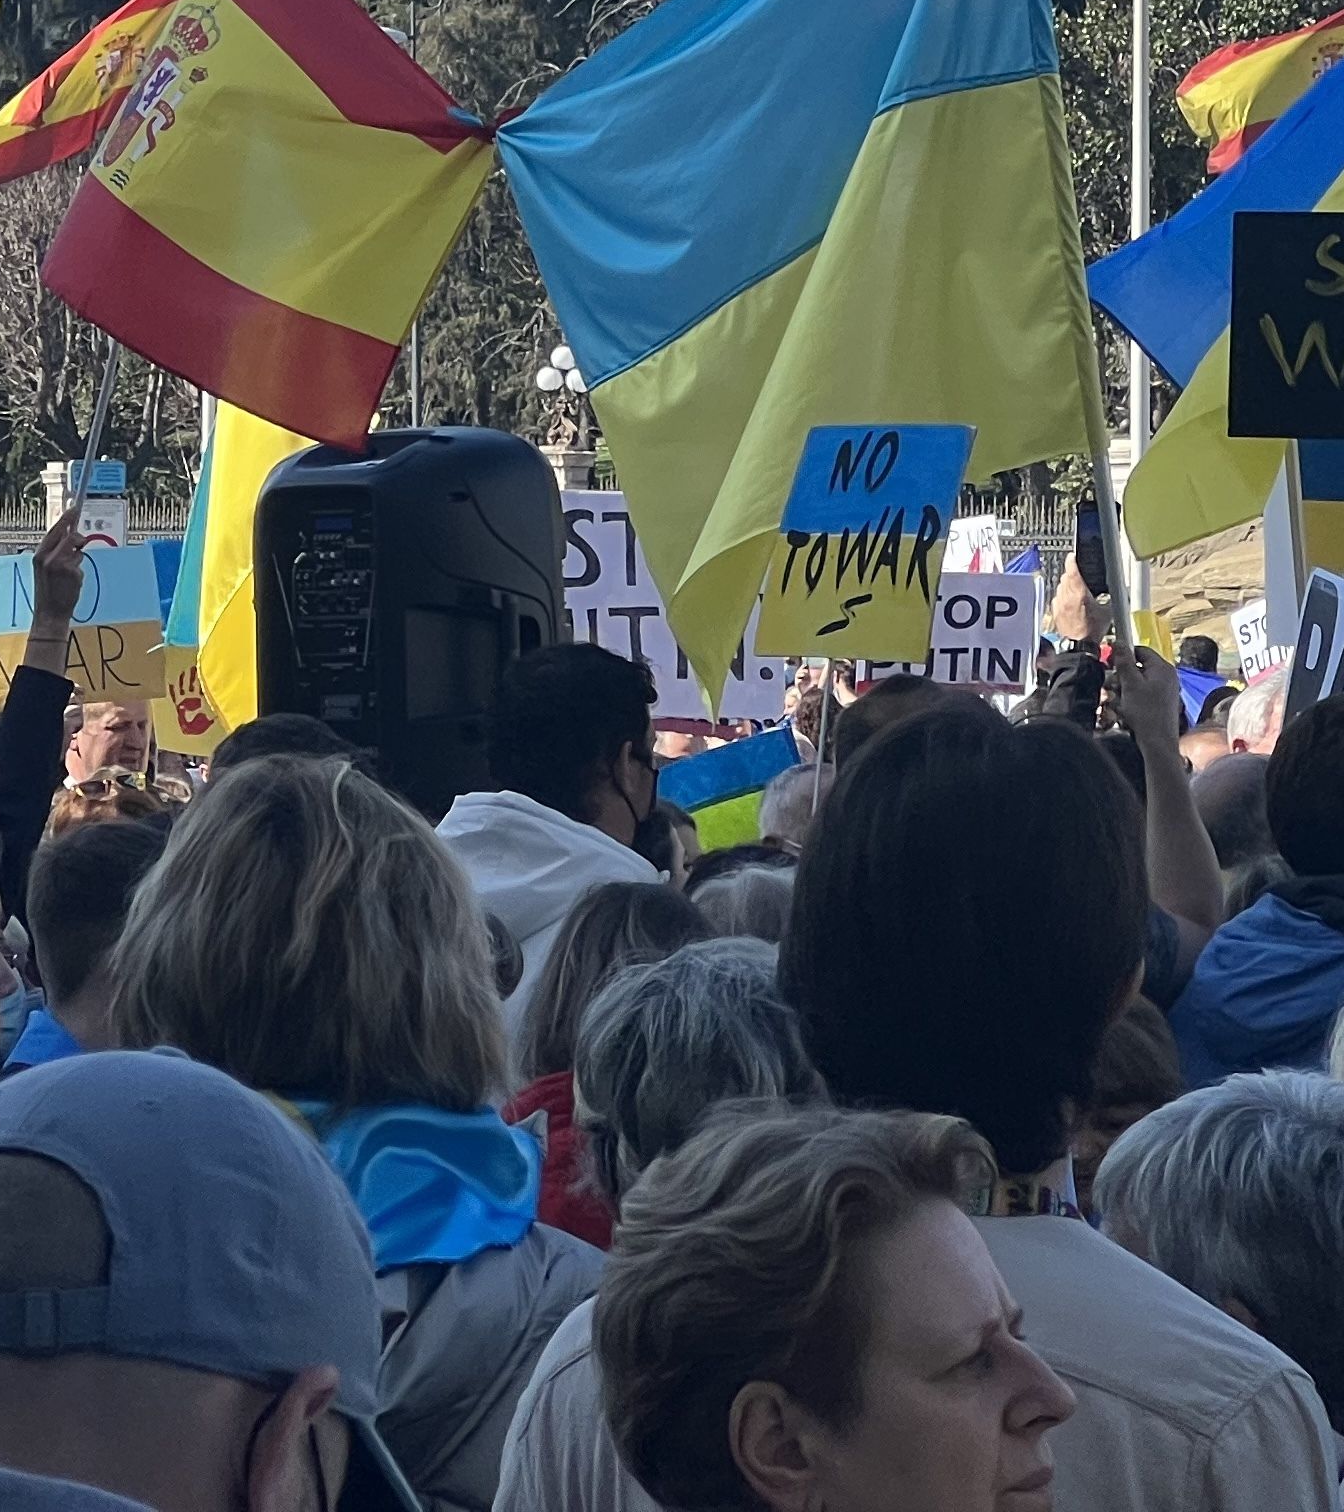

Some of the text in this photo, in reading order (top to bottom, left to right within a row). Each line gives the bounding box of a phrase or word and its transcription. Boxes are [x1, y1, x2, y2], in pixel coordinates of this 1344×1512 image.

[828, 429, 900, 496] NO
[563, 508, 637, 589] ST
[11, 551, 101, 628] NO
[936, 594, 1018, 630] OP
[1239, 615, 1267, 645] ST
